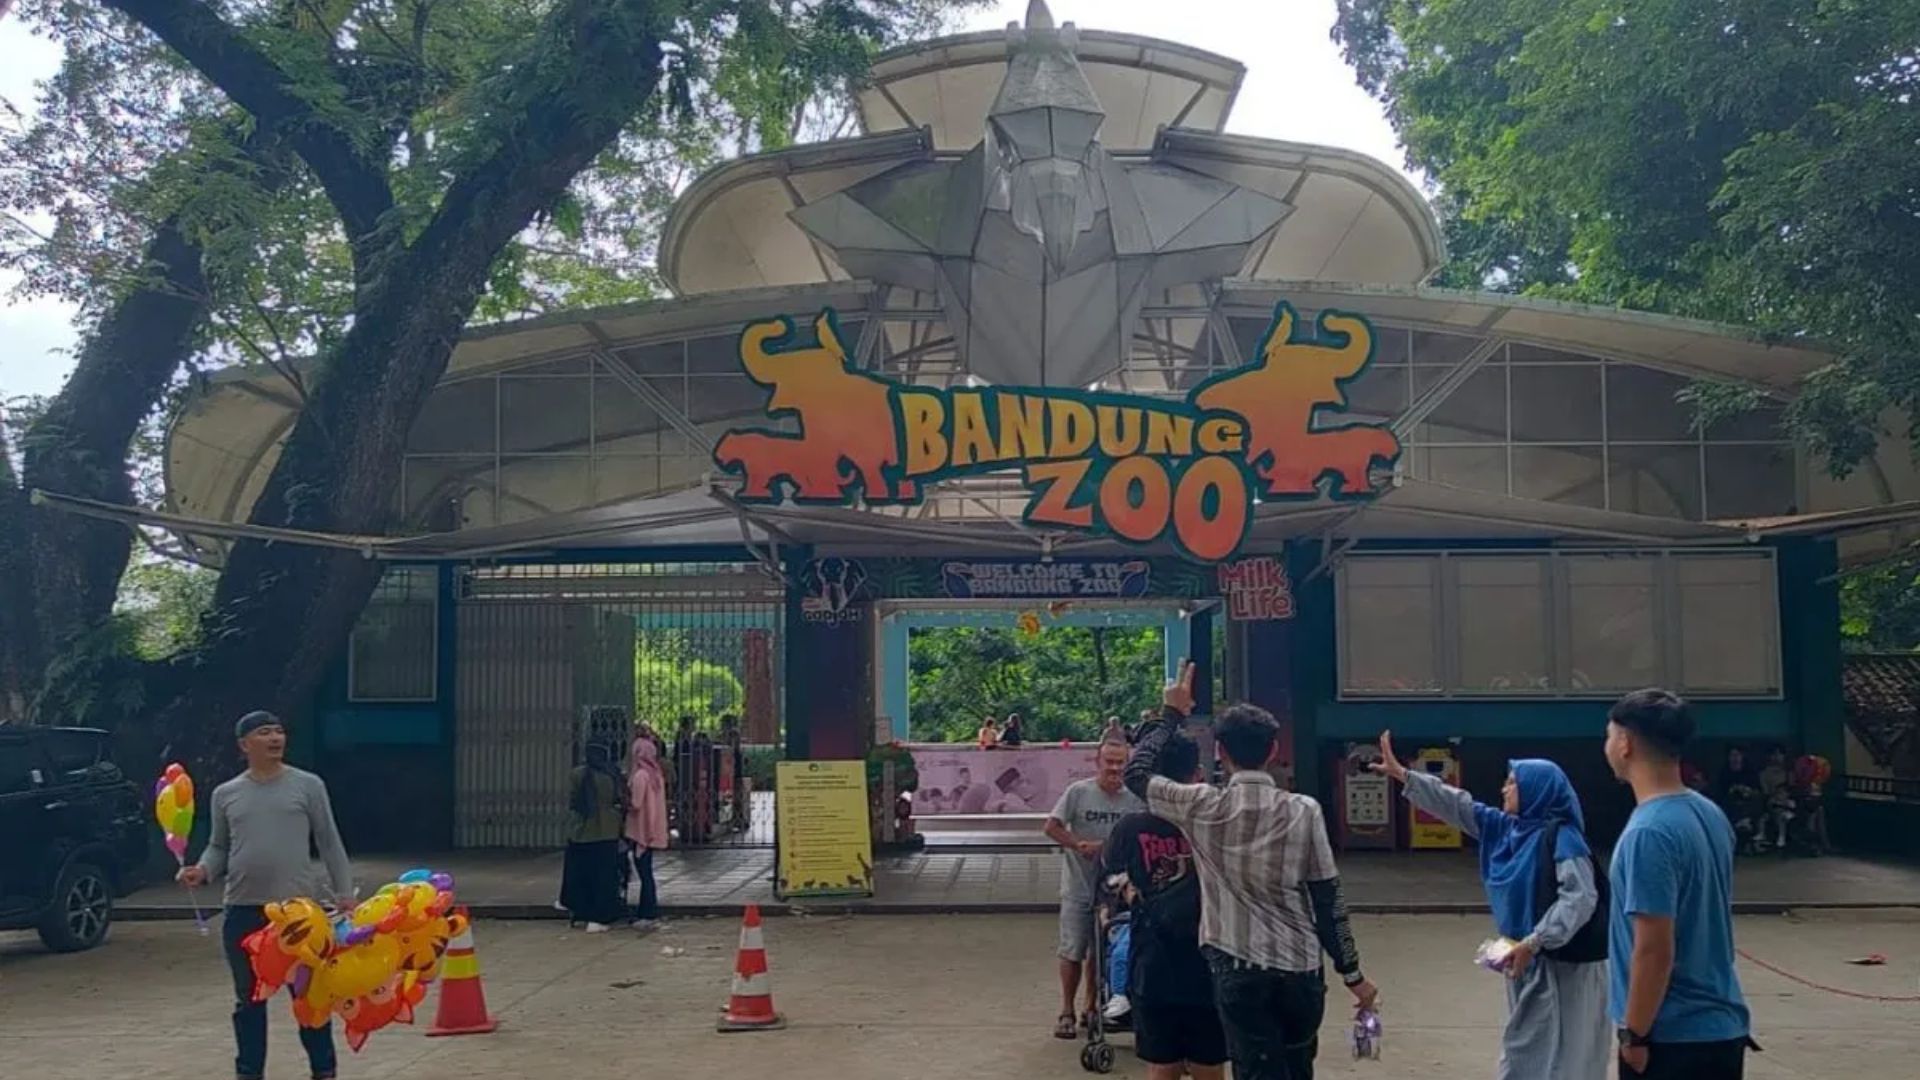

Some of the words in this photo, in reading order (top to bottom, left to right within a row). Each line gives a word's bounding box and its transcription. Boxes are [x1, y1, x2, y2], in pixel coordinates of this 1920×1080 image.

[900, 392, 1243, 476] BANDUNG
[1027, 455, 1247, 560] ZOO
[970, 562, 1085, 579] WELCOME
[1090, 562, 1121, 579] TO
[970, 578, 1073, 594] BANDUNG
[1078, 578, 1122, 594] ZOO
[1218, 558, 1289, 592] Milk
[1231, 588, 1293, 619] Life
